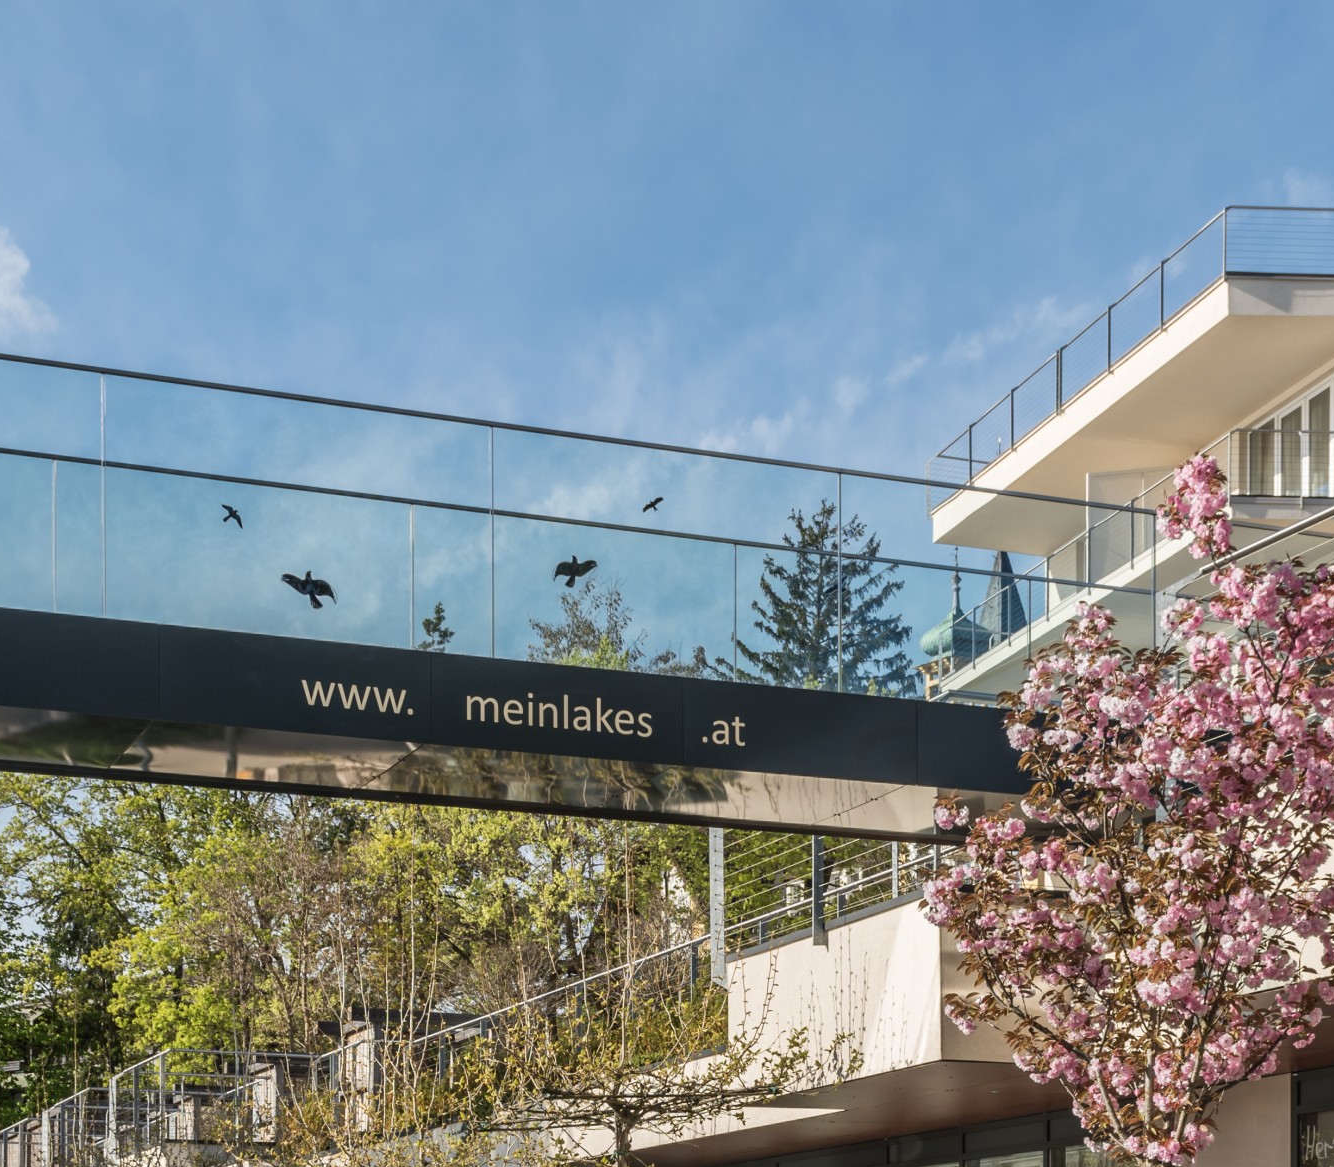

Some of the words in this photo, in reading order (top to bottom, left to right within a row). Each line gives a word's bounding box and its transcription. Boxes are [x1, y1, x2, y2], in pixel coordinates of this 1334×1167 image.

[301, 679, 414, 715] www.
[466, 693, 653, 738] meinlakes
[701, 716, 746, 747] .at
